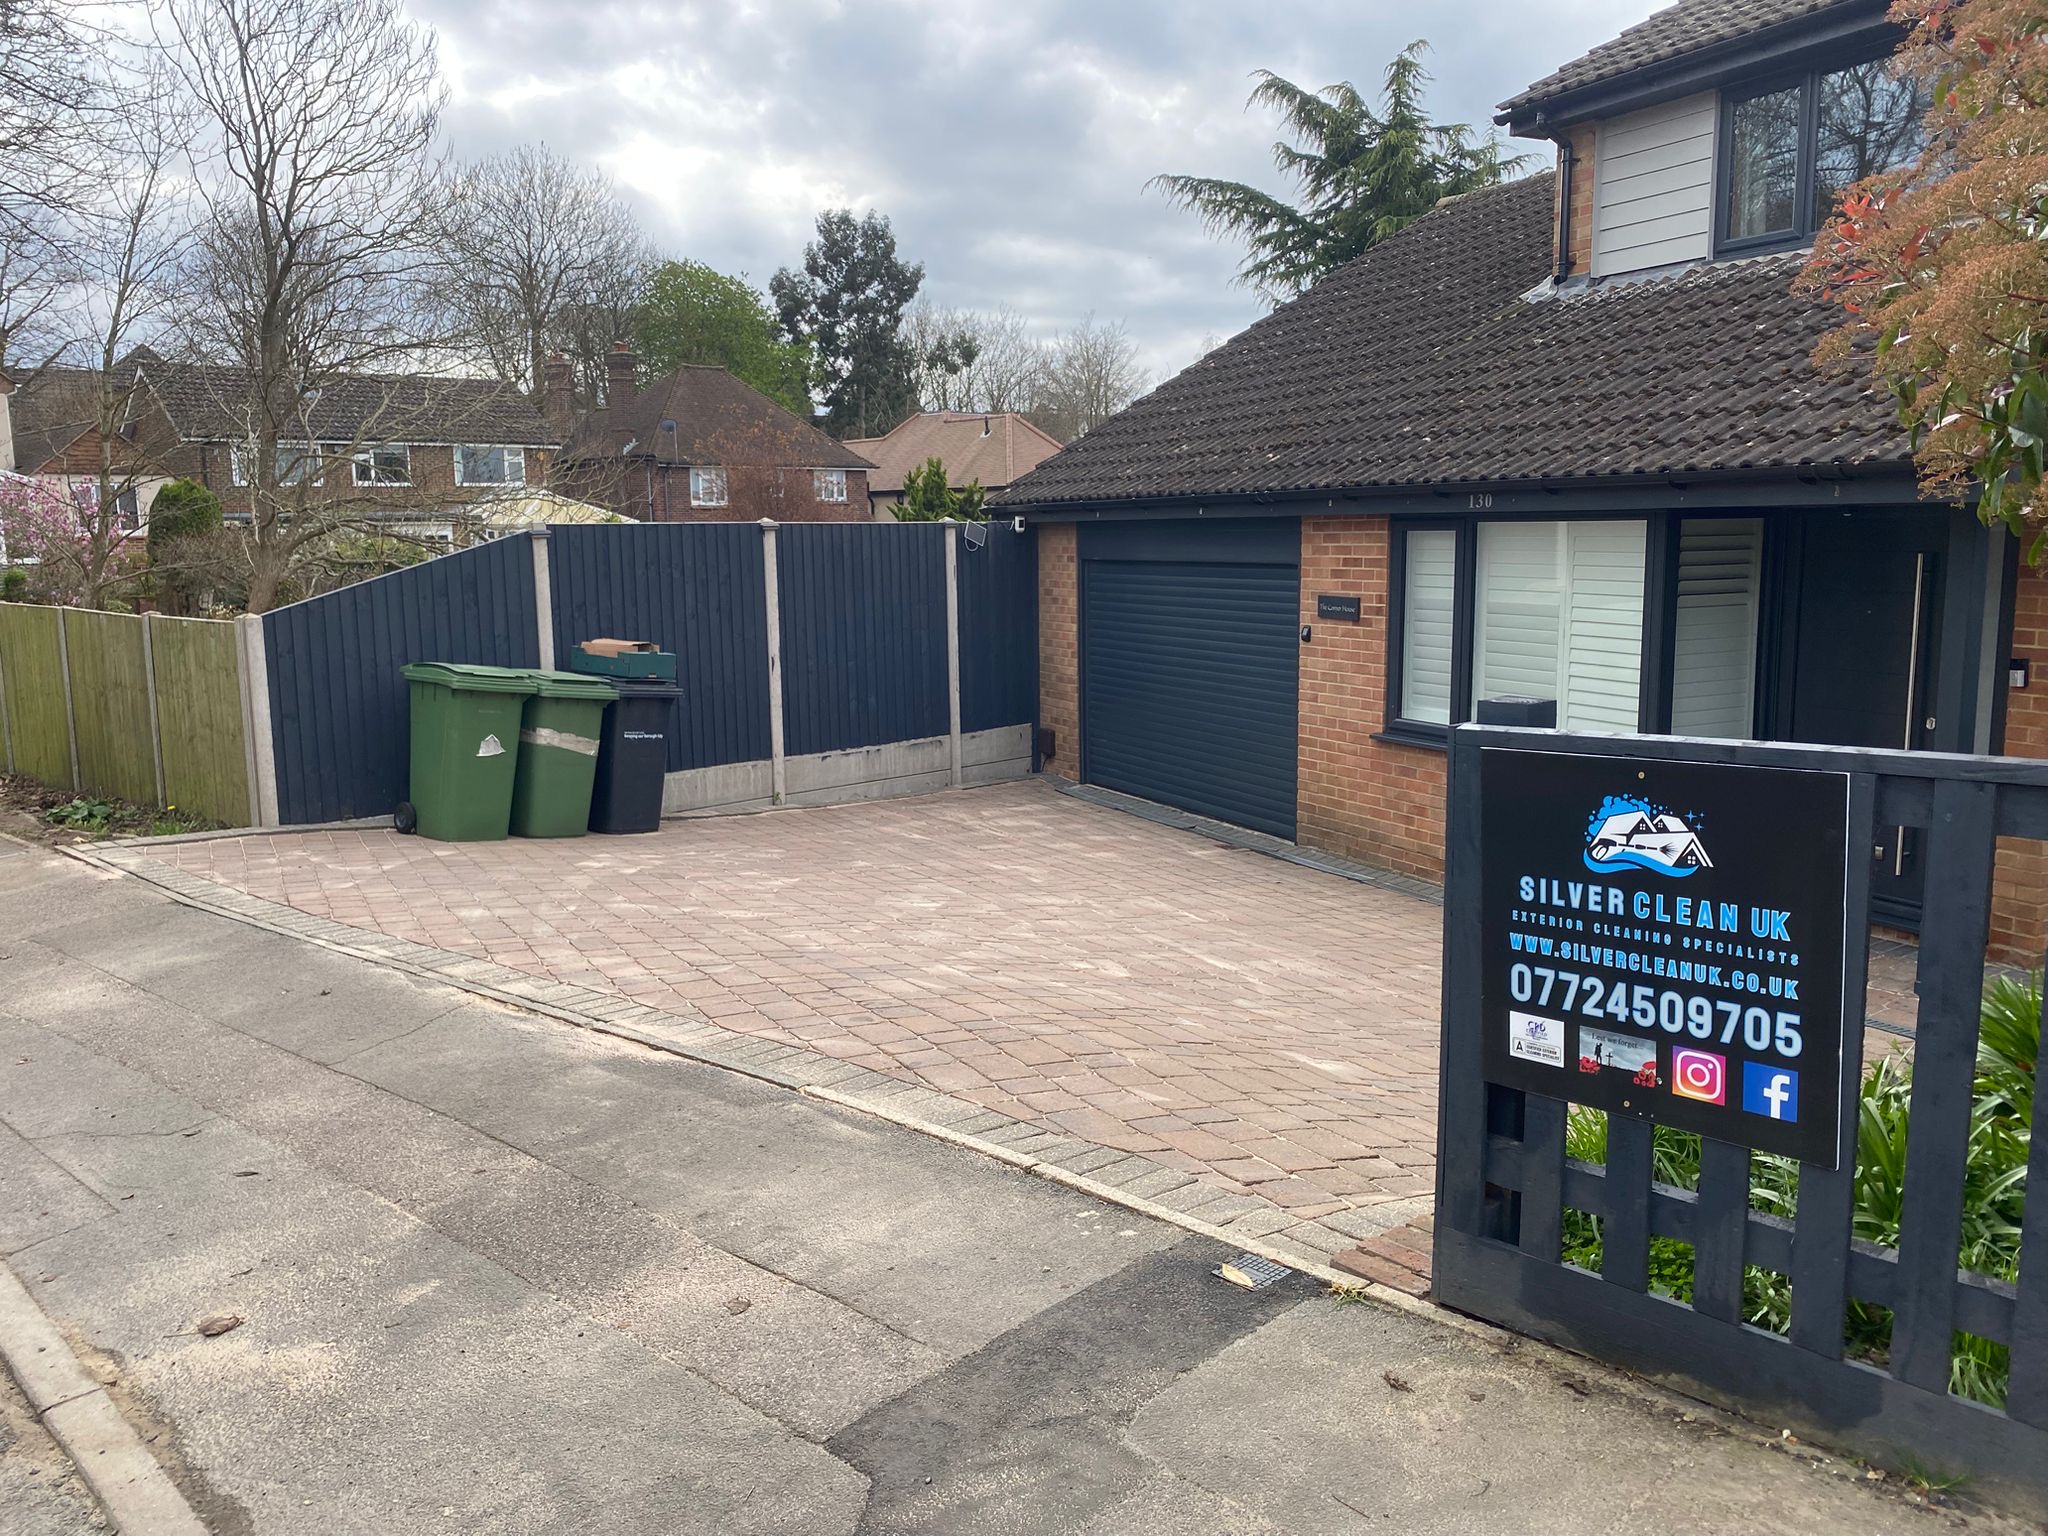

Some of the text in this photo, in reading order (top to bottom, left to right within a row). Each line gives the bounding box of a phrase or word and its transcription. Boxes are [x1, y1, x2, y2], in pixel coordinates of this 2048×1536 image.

[1468, 493, 1492, 509] 130
[1512, 909, 1799, 966] EXTERIOR CLEANING SPECIALISTS
[1519, 875, 1791, 941] SILVER CLEAN UK
[1509, 932, 1799, 1000] WWW.SILVERCLEANUK.CO.UK
[1510, 962, 1803, 1058] 07724509705
